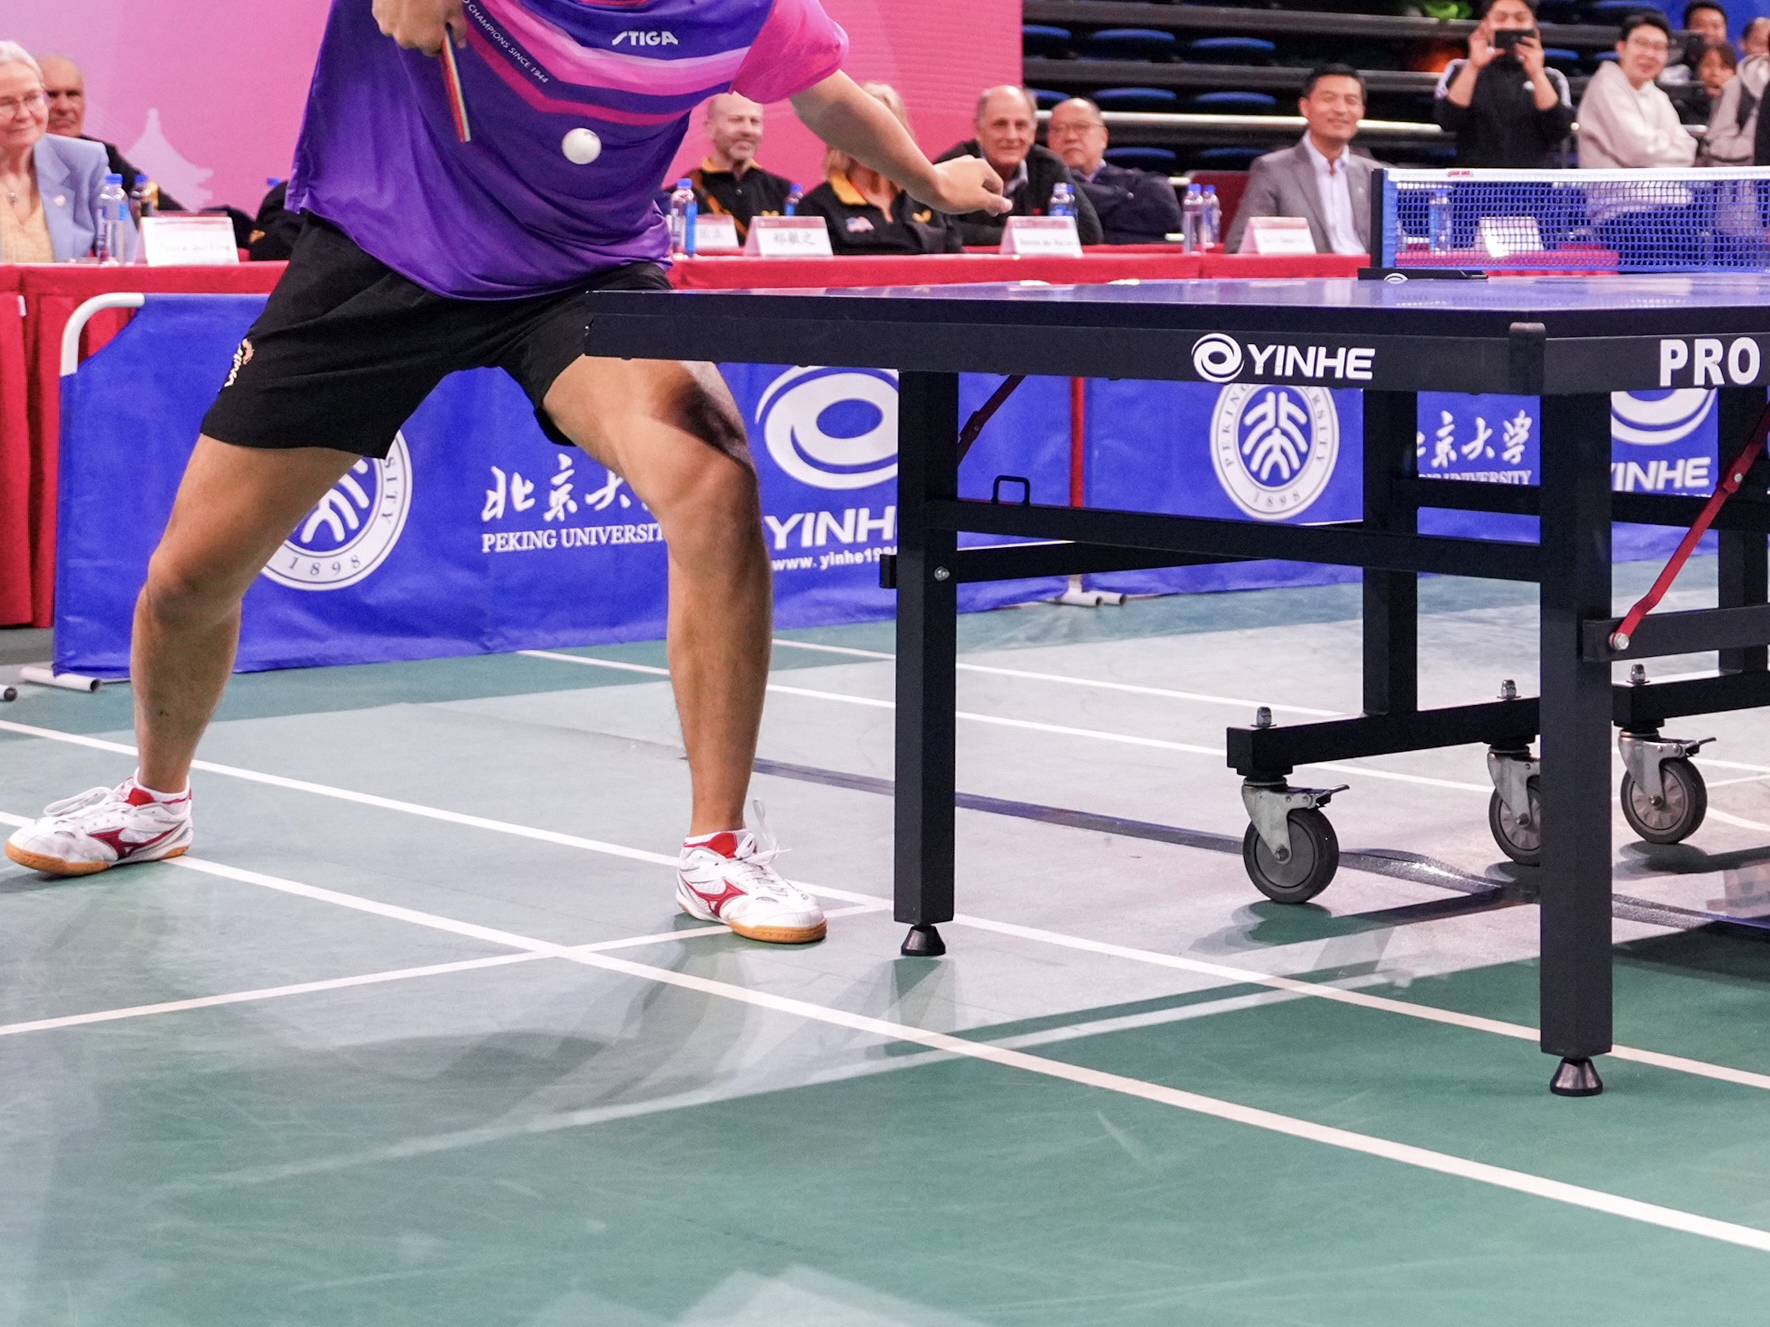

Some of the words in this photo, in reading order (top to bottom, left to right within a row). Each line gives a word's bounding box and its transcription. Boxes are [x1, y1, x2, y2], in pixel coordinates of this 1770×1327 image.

[468, 4, 510, 49] CHAMPIONS
[508, 47, 531, 68] SINCE
[530, 67, 549, 83] 1944
[612, 31, 679, 46] STIGA
[1247, 344, 1376, 380] YINHE
[1660, 337, 1760, 387] PRO
[481, 453, 649, 522] 北京大
[1611, 457, 1712, 492] INHE
[1253, 490, 1301, 507] 1898
[482, 529, 557, 553] PEKING
[560, 523, 664, 548] UNIVERSIT
[764, 505, 897, 550] YINH
[288, 554, 361, 576] 1898
